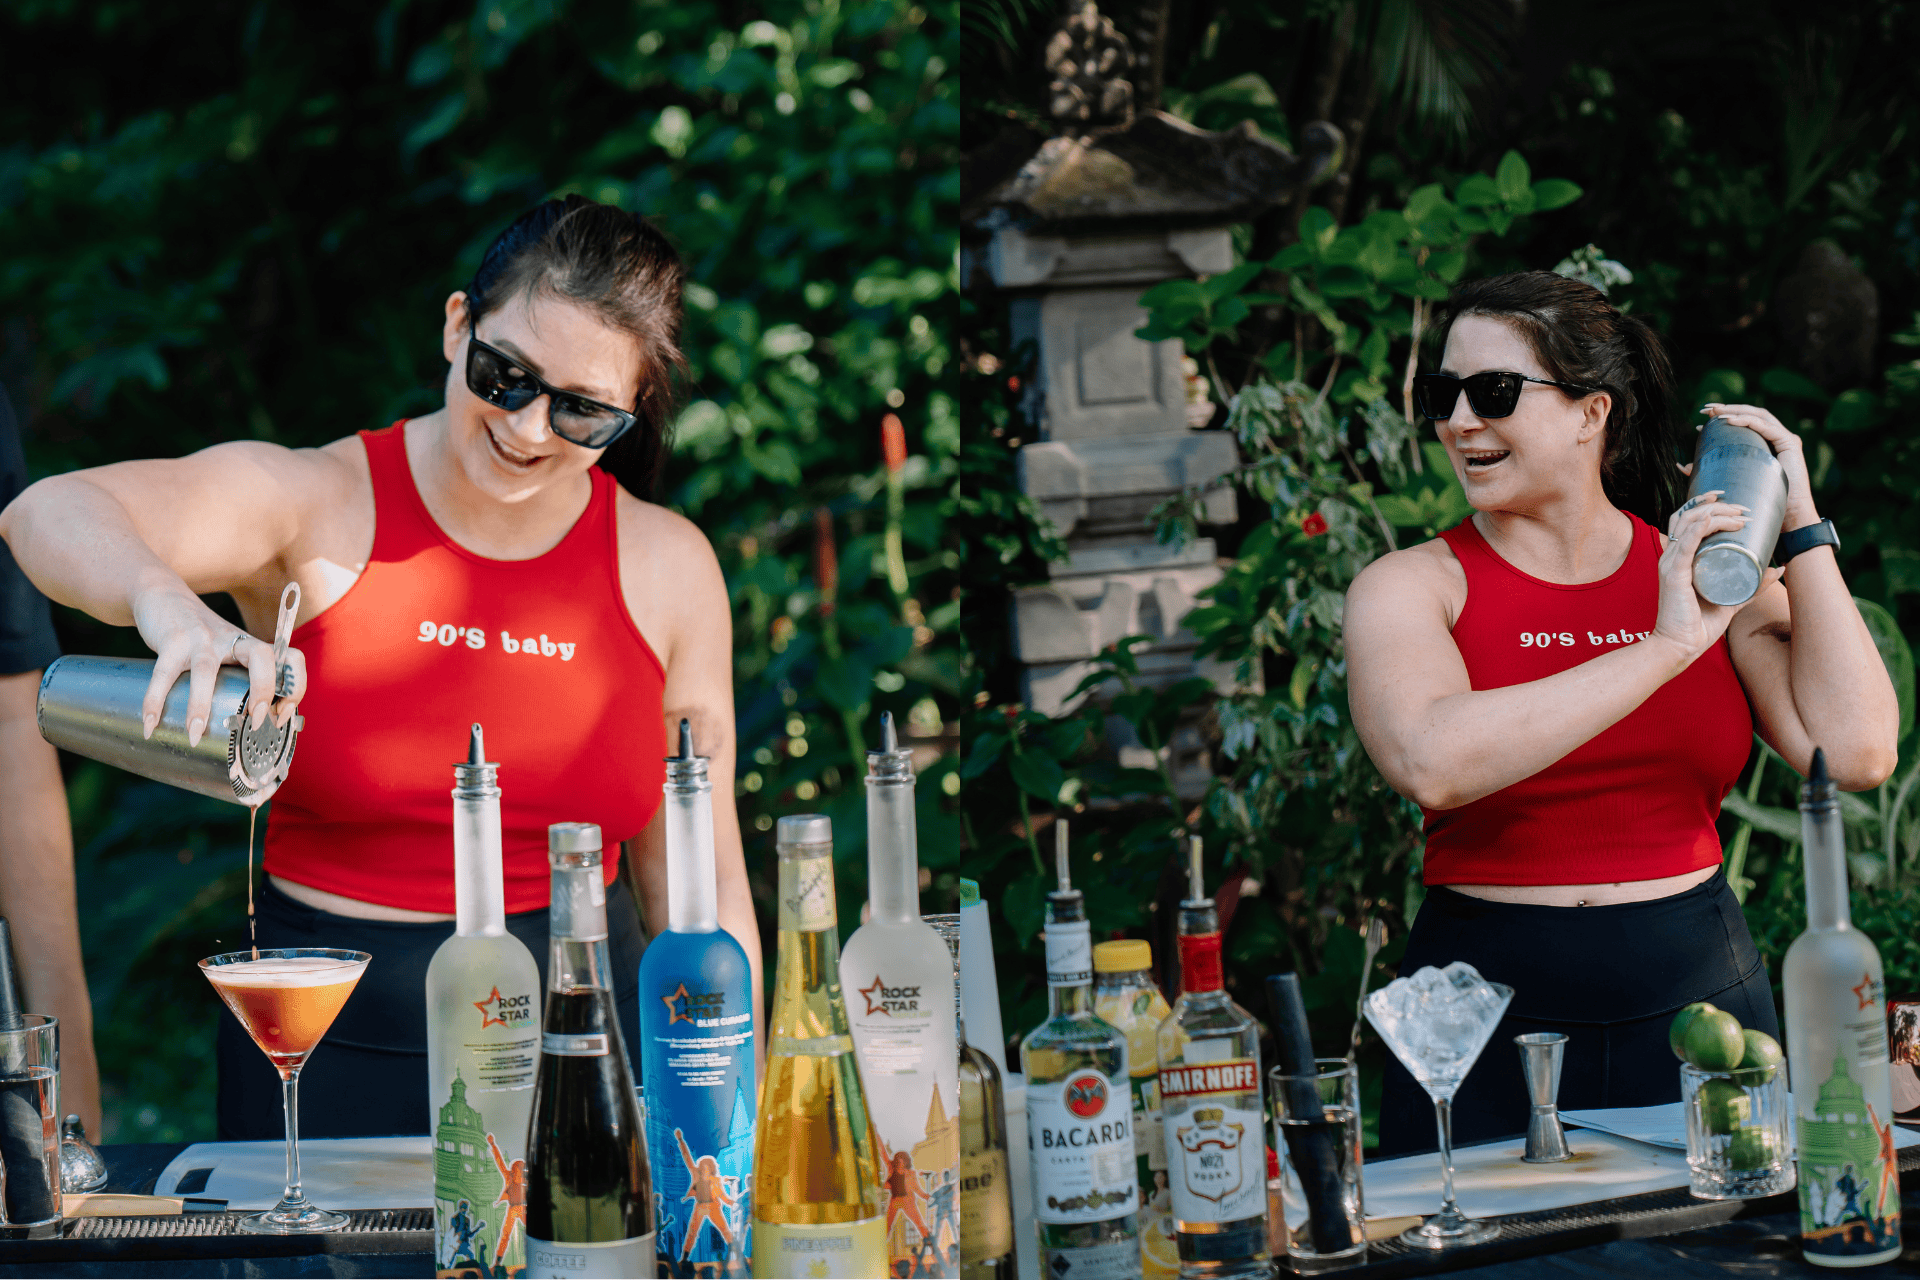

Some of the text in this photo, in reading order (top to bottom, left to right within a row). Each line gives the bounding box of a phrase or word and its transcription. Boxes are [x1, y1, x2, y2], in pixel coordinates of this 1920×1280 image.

[418, 621, 576, 661] 90'S baby
[1520, 632, 1575, 648] 90'S
[685, 992, 725, 1006] ROCK
[881, 986, 921, 998] ROCK
[499, 995, 530, 1009] ROCK
[881, 1000, 918, 1012] STAR
[499, 1008, 530, 1021] STAR
[696, 1018, 720, 1028] BLUE
[1160, 1064, 1254, 1094] SMIRNOFF
[1194, 1170, 1230, 1180] VODKA
[782, 1235, 854, 1252] PINEAPPLE
[535, 1250, 586, 1270] COFFEE
